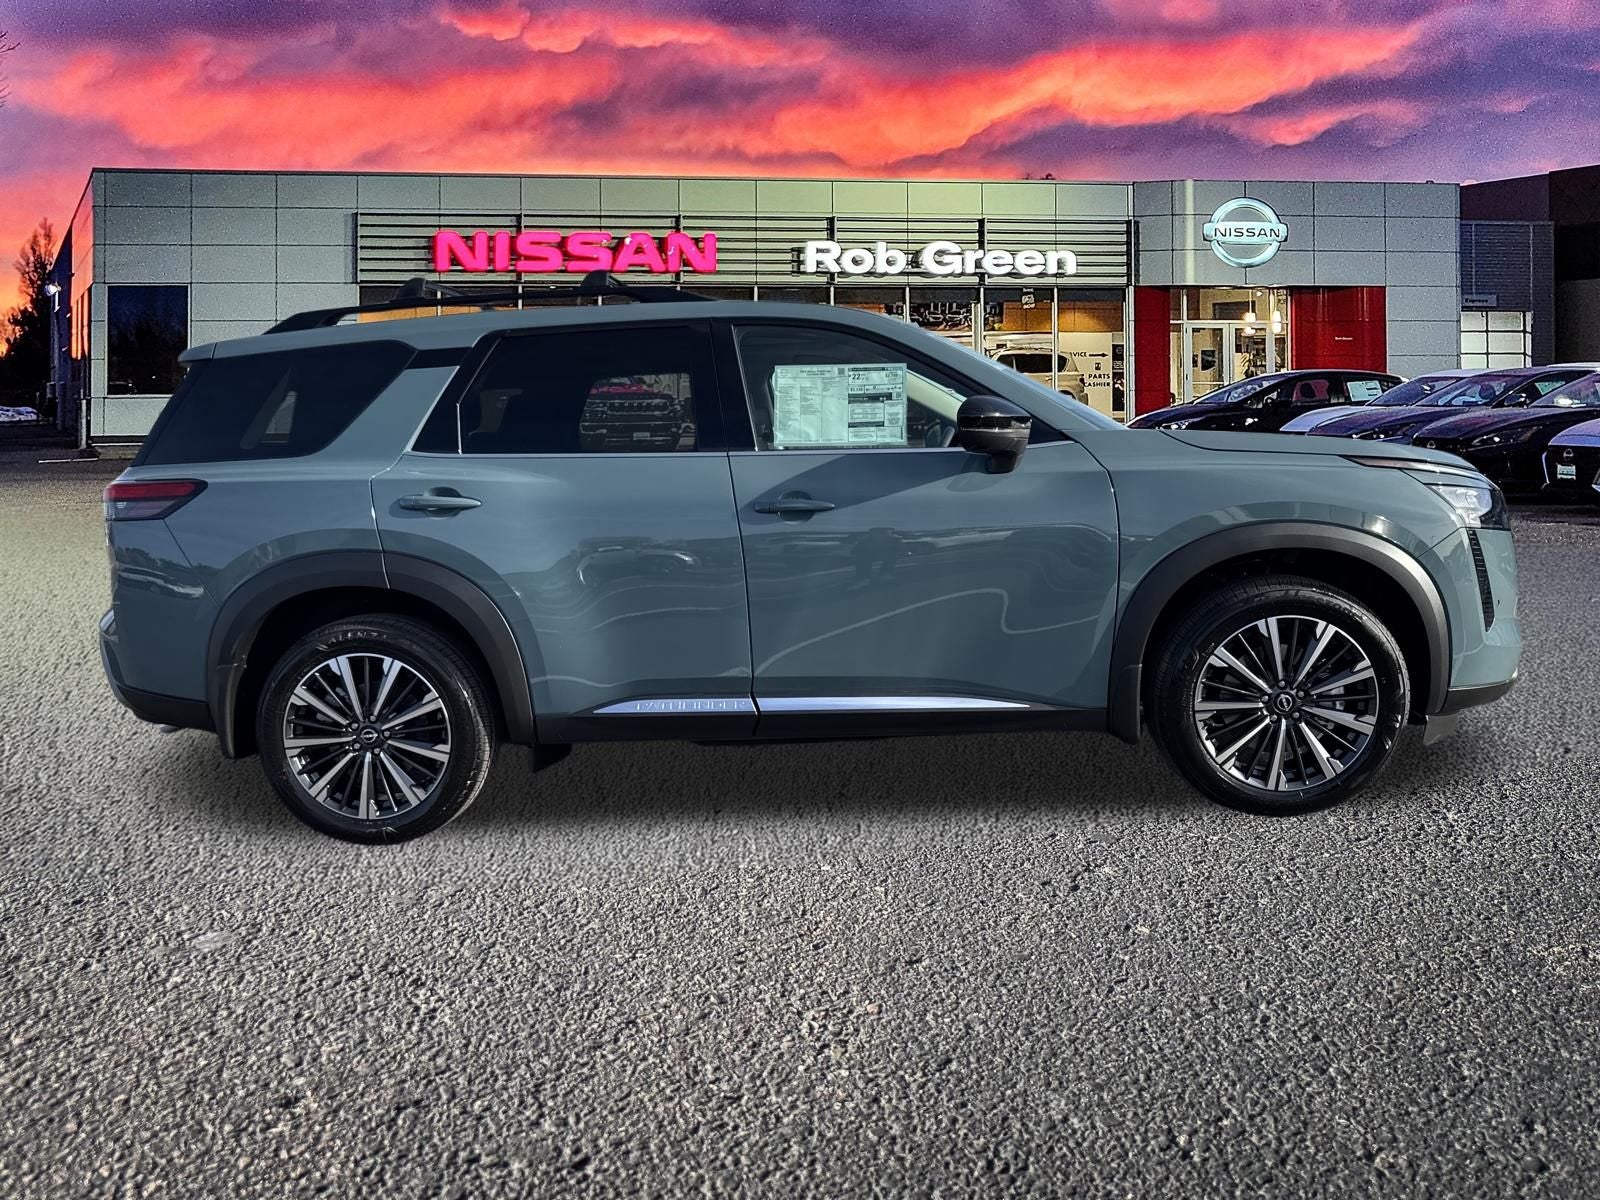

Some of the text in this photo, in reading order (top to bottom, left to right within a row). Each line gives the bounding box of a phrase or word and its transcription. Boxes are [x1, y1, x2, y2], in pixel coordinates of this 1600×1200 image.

[1214, 227, 1280, 238] NISSAN
[434, 230, 718, 273] NISSAN
[804, 240, 1078, 277] Rob Green
